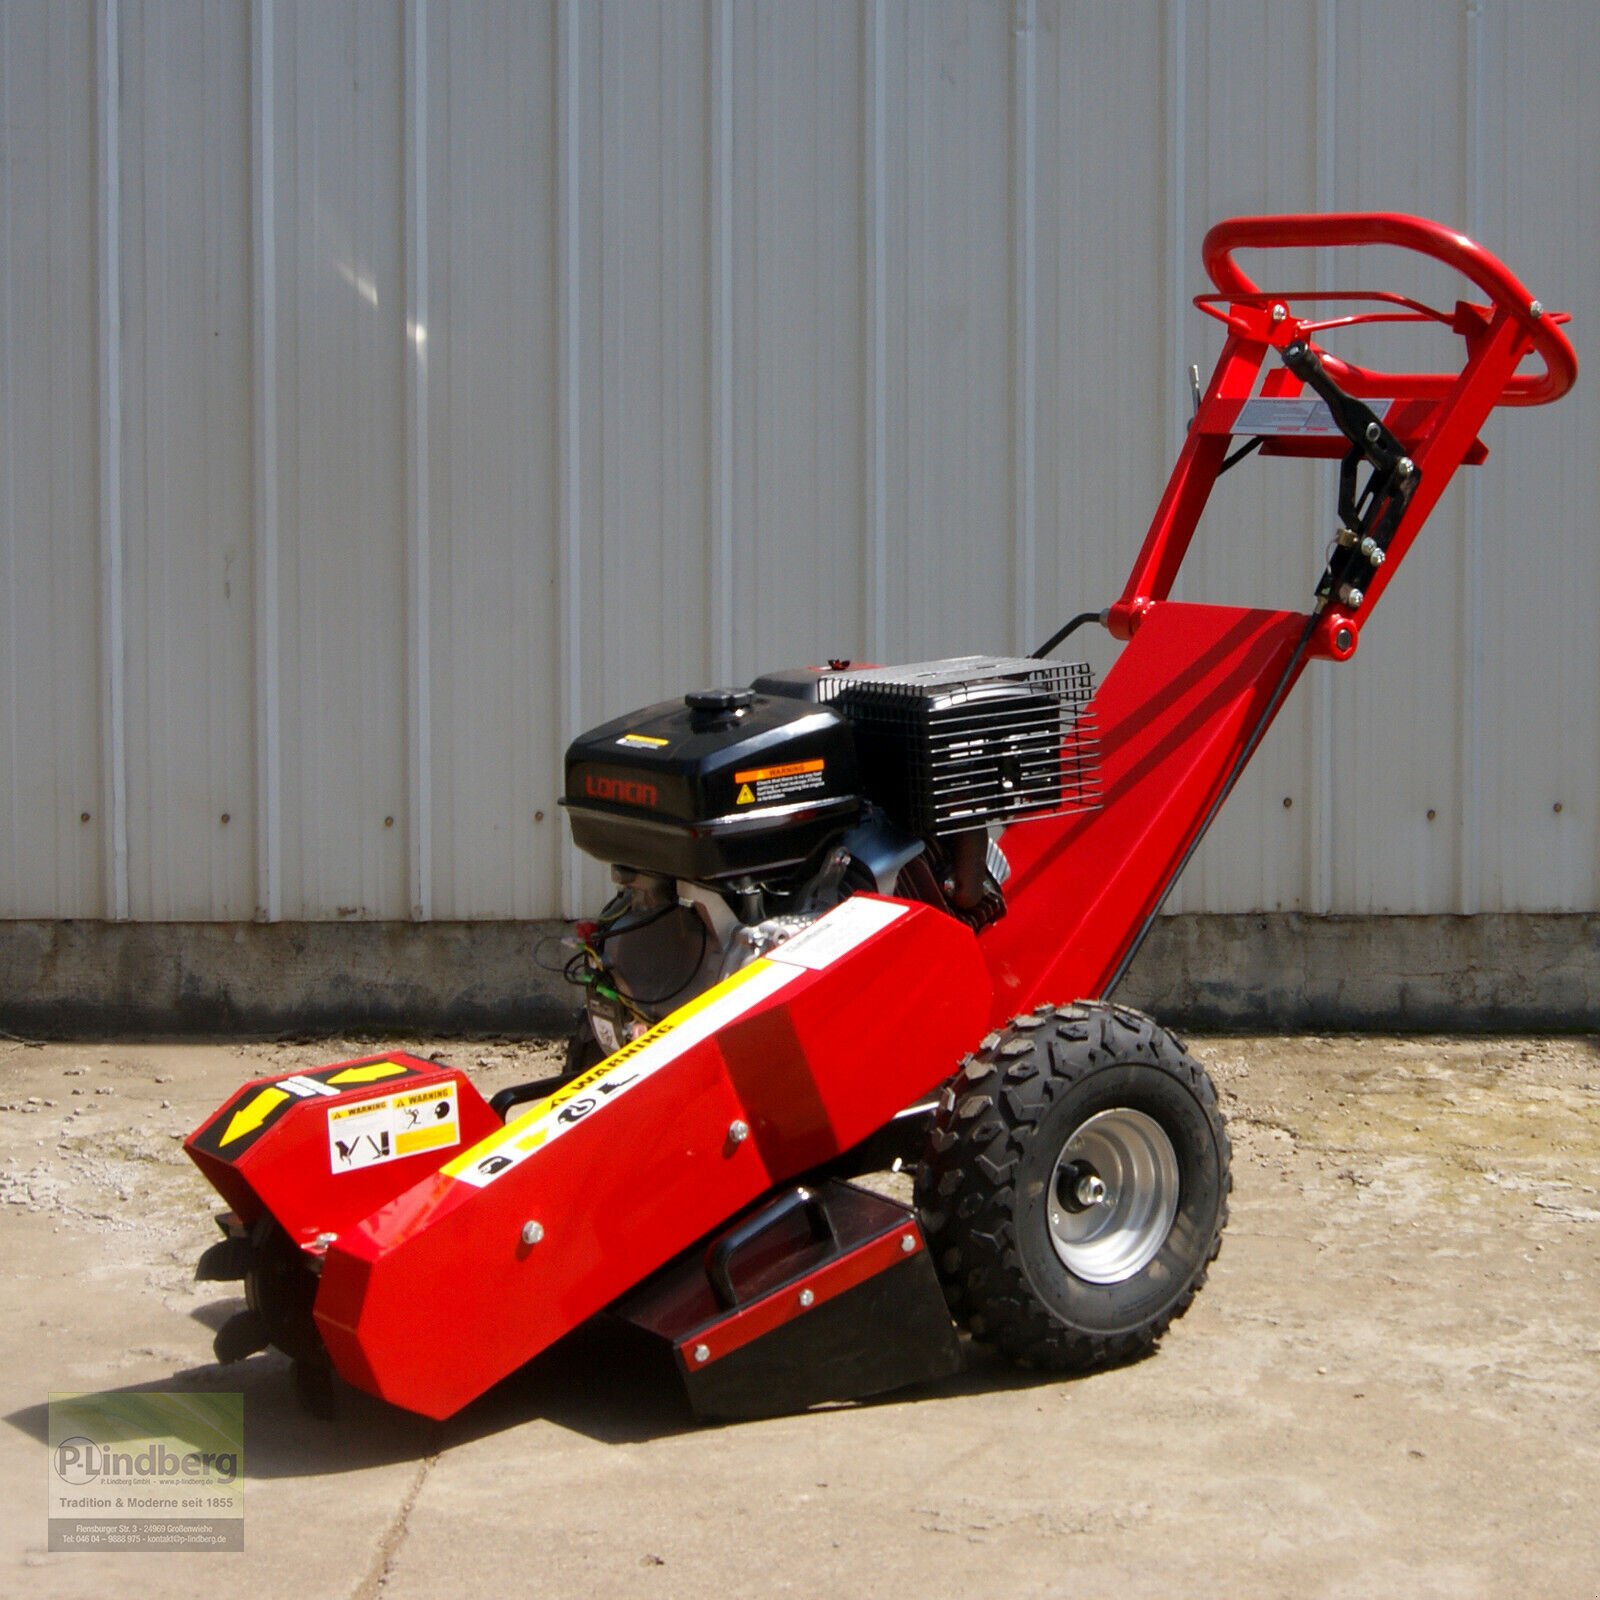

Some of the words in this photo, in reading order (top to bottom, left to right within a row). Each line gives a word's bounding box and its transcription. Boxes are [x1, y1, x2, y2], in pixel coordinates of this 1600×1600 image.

[571, 1025, 674, 1090] WARNING
[408, 1089, 448, 1104] WARNING
[348, 1101, 386, 1116] WARNING
